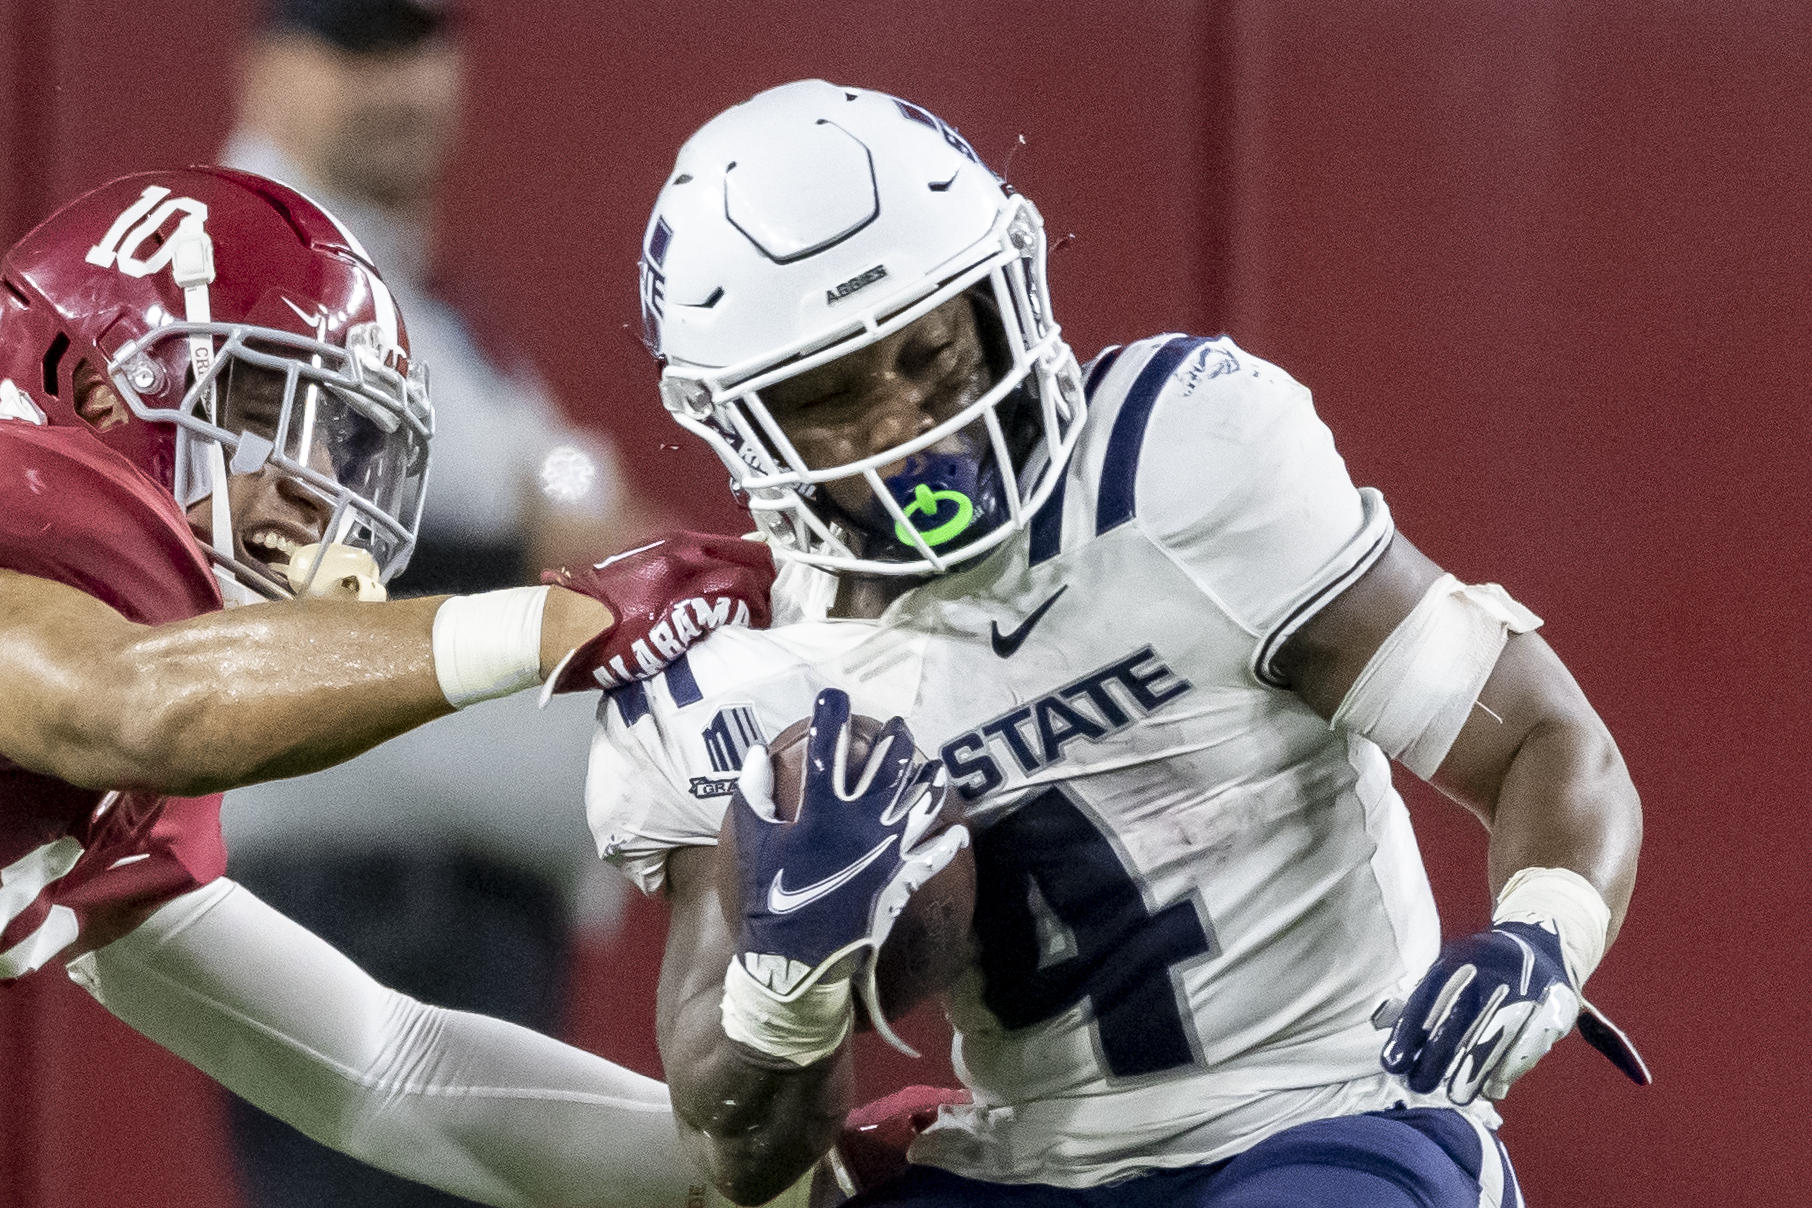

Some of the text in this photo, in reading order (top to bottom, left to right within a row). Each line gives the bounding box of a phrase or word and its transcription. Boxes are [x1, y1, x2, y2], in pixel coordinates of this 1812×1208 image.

[85, 185, 209, 279] 10
[826, 264, 888, 306] AGGIES
[938, 643, 1193, 801] STATE
[971, 784, 1220, 1086] 4
